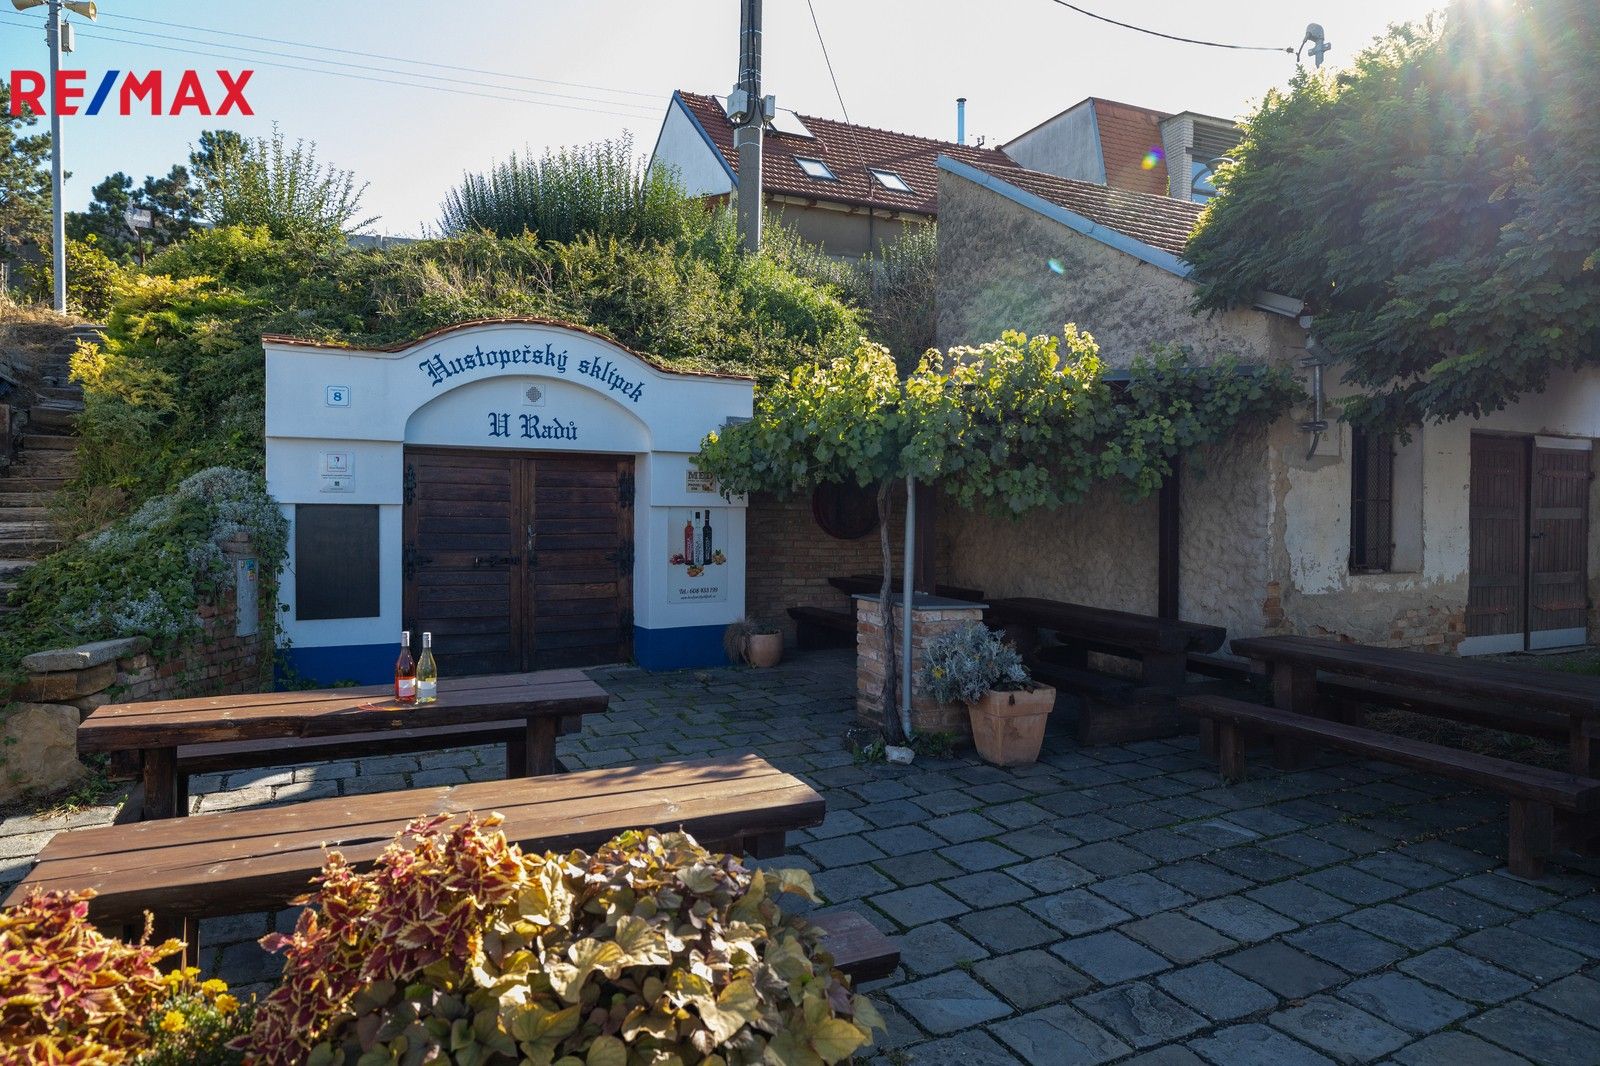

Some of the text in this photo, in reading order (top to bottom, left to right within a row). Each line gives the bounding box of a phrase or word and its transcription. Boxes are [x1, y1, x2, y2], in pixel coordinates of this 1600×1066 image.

[419, 344, 645, 403] Hustopečský sklípek
[333, 391, 342, 401] 8
[519, 413, 578, 441] Radů
